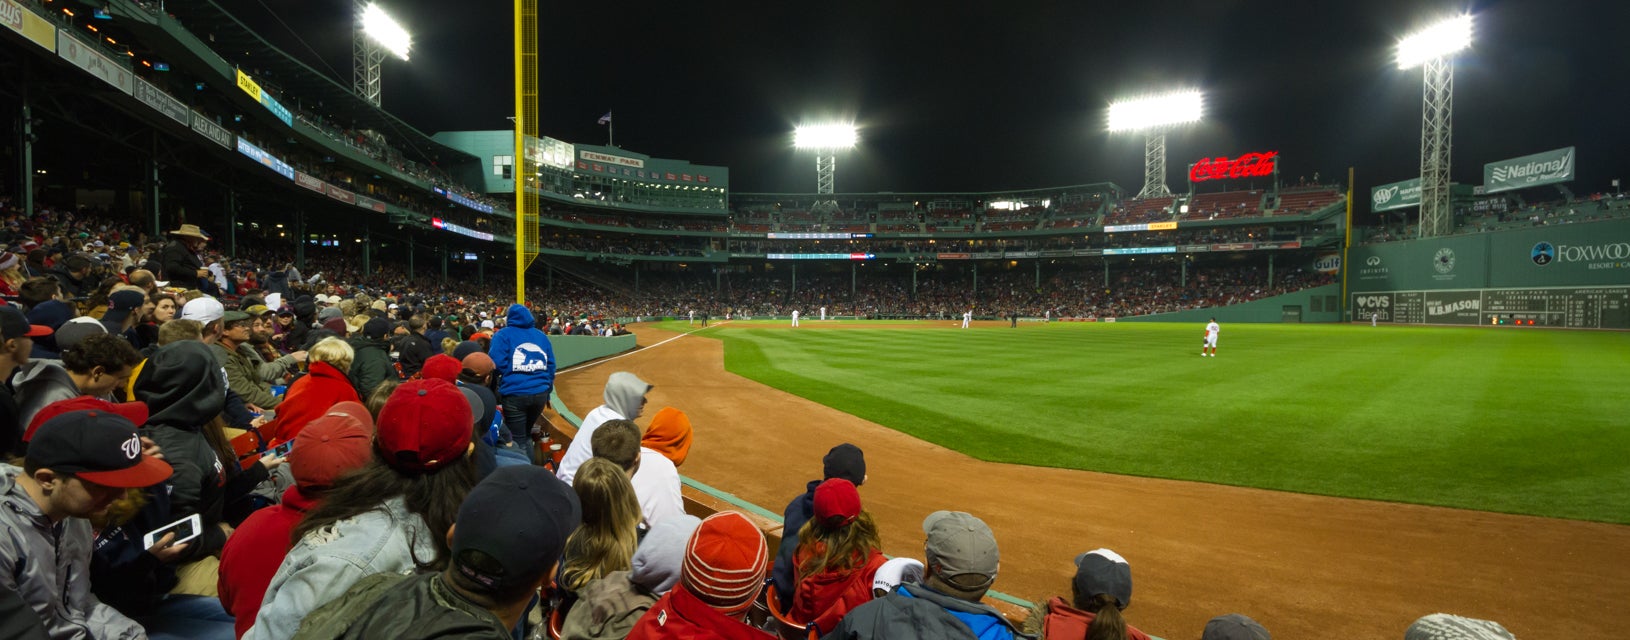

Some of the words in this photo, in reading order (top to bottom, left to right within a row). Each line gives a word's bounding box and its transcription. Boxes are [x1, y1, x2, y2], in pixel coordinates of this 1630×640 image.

[240, 76, 259, 97] STANLEY
[194, 116, 208, 134] ALEX
[208, 124, 220, 140] AND
[584, 152, 616, 163] FENWAY
[619, 158, 641, 167] PARK
[1190, 150, 1278, 183] Coca-Cola
[1507, 155, 1568, 179] National
[1557, 242, 1630, 263] FOXWOO
[1315, 258, 1340, 269] Gulf
[1588, 262, 1614, 270] RESORT
[1366, 295, 1389, 308] CVS
[121, 432, 141, 460] W
